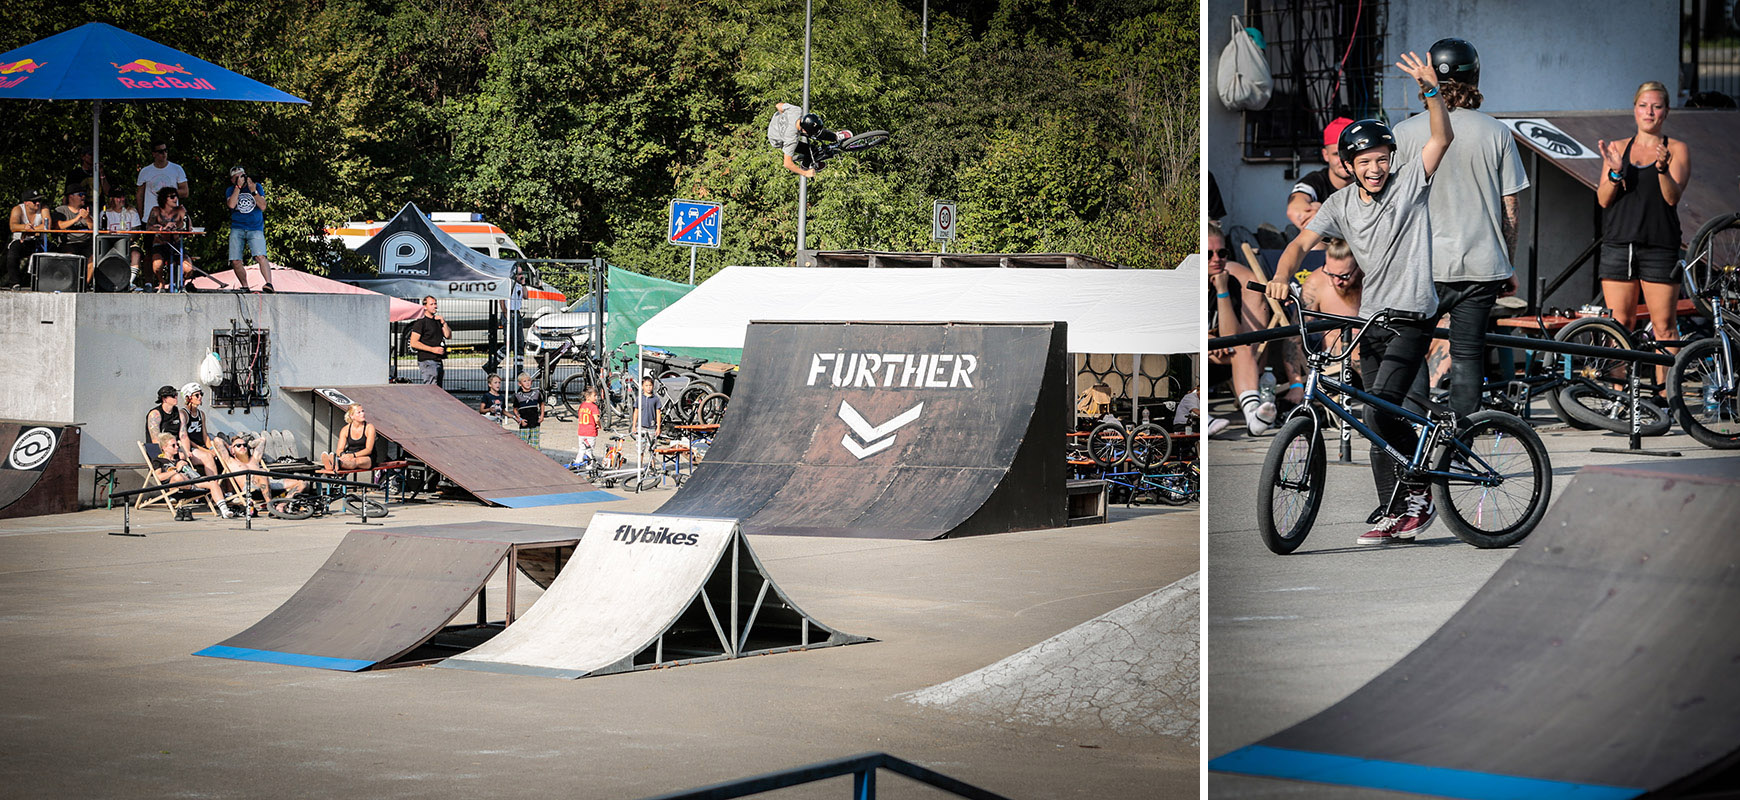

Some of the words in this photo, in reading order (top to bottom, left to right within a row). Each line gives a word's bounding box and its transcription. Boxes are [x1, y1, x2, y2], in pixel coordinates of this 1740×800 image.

[117, 76, 171, 89] Red
[165, 77, 216, 90] Bull
[941, 211, 949, 224] 30
[449, 281, 497, 294] primo
[806, 352, 978, 388] FURTHER
